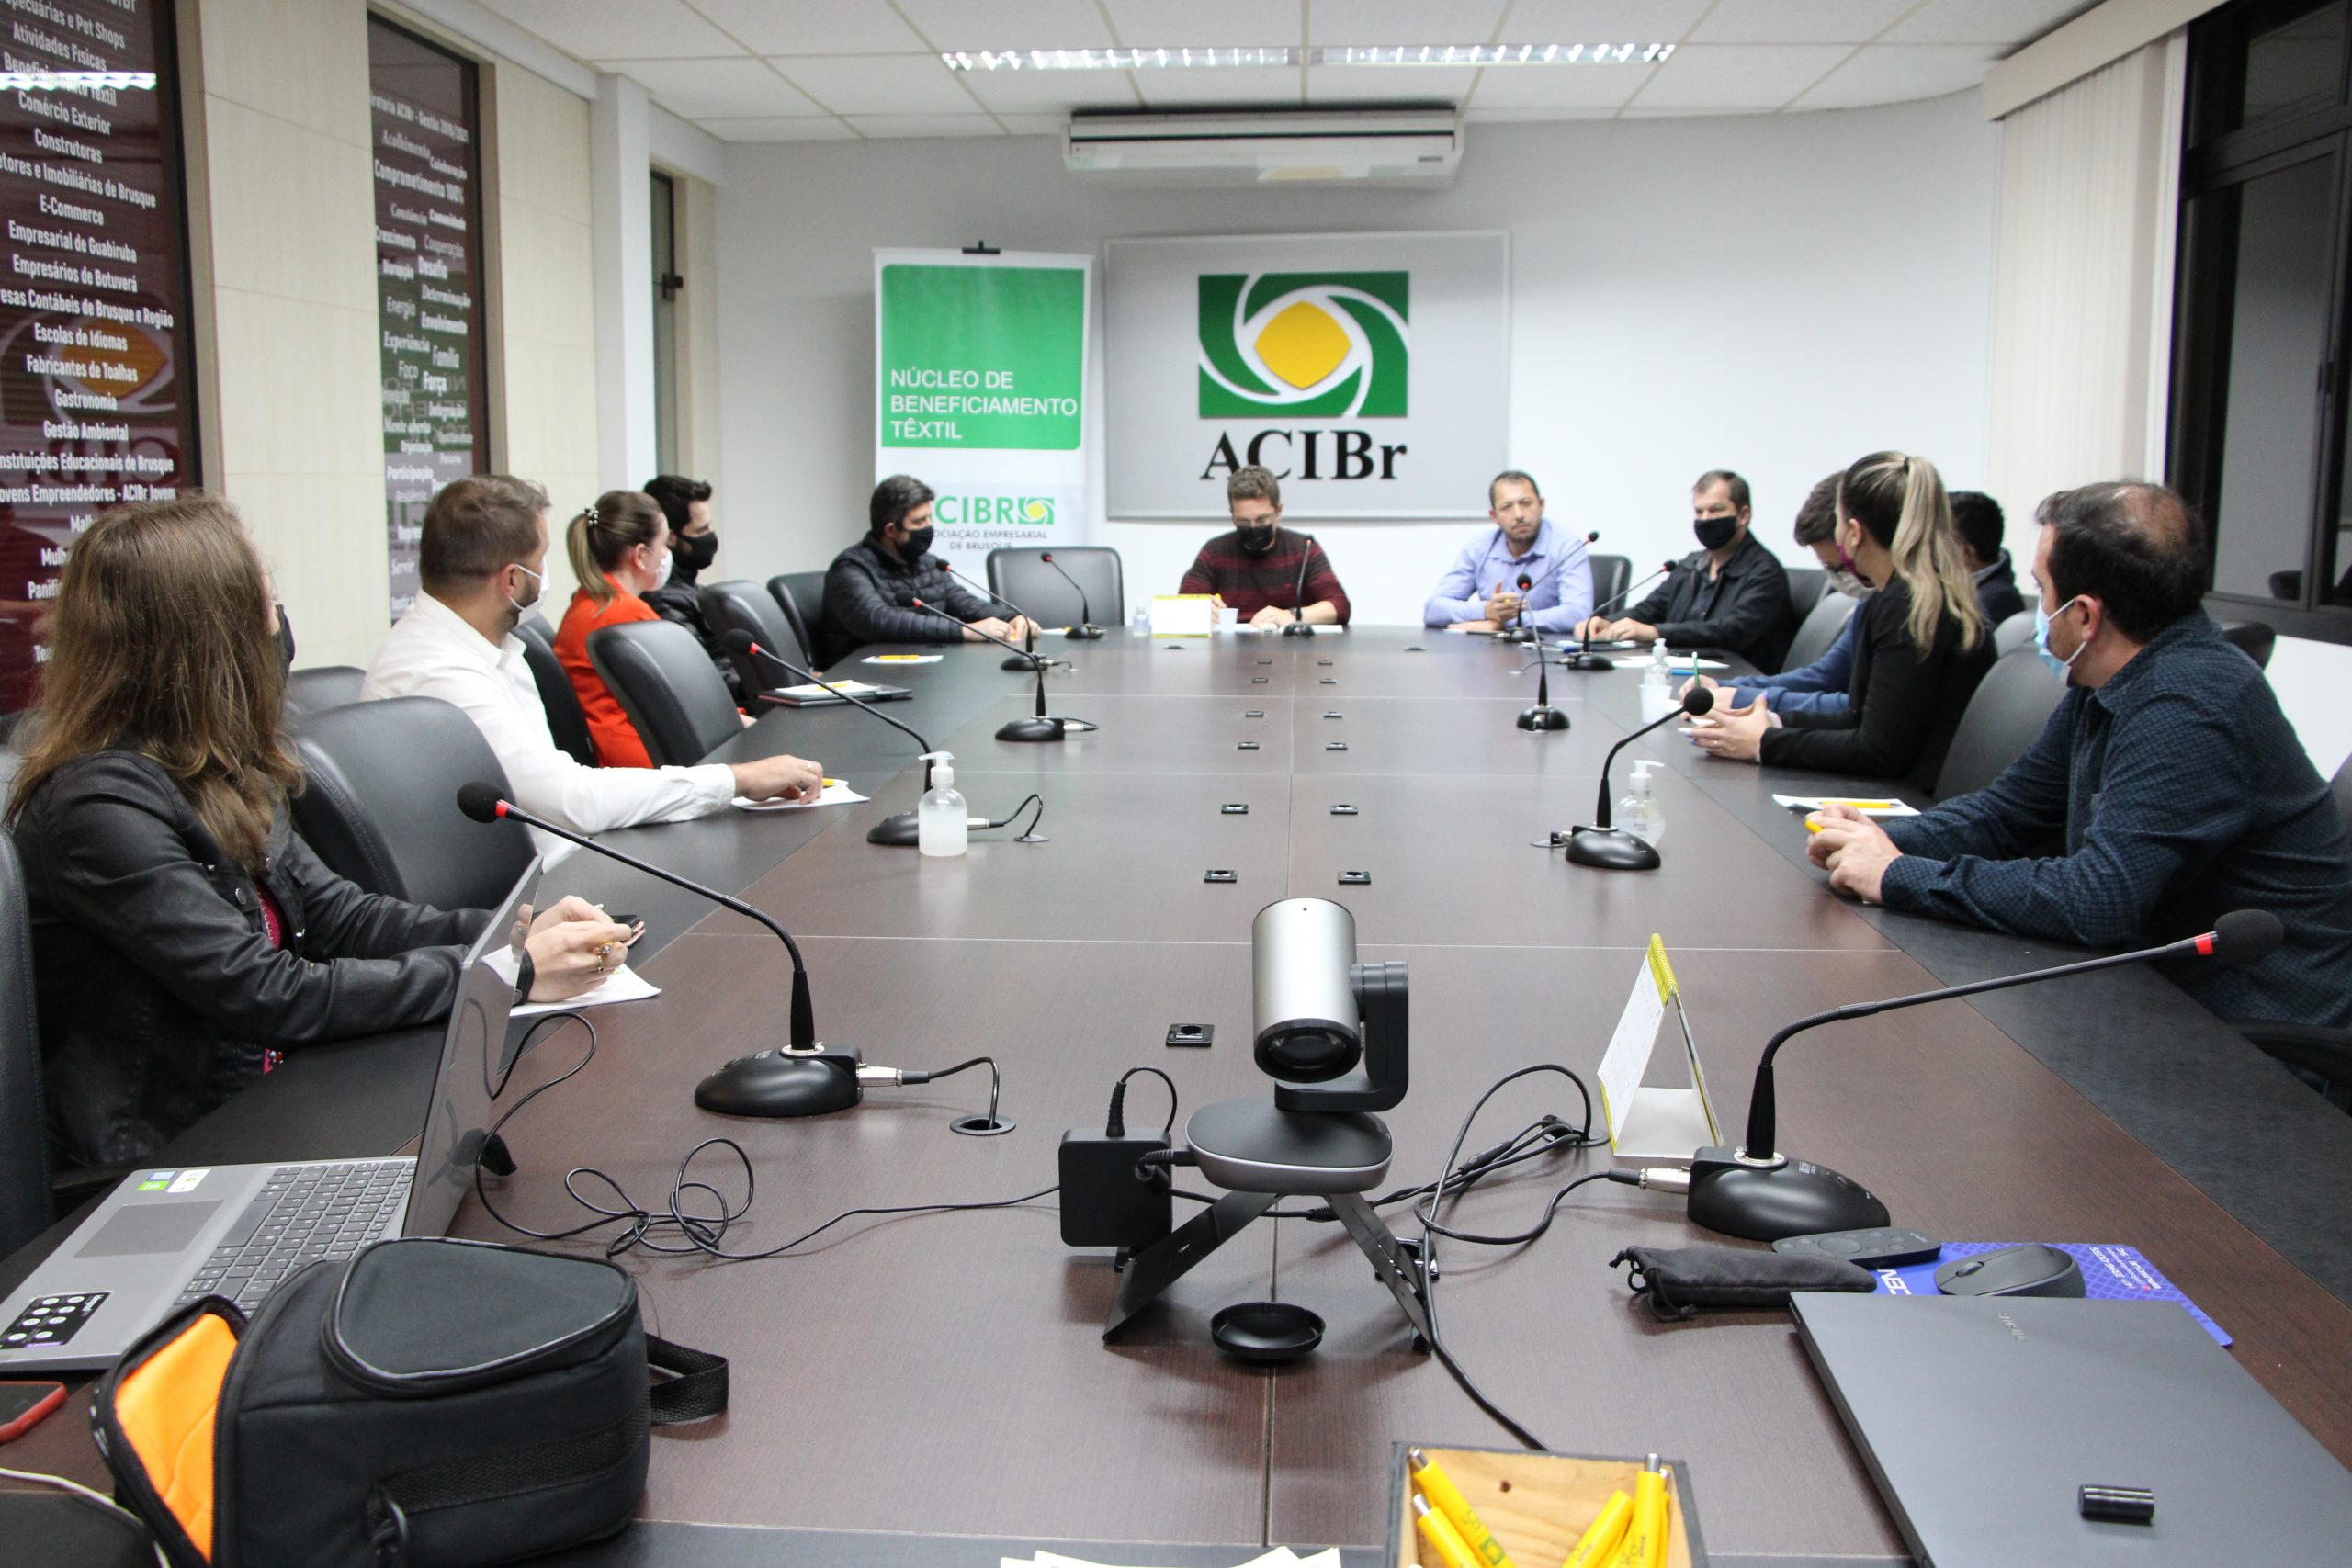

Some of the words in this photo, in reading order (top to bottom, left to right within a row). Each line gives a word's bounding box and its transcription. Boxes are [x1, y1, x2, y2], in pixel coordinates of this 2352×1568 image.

[13, 22, 71, 60] Atividades
[76, 14, 94, 36] Pet
[96, 22, 126, 49] Shops
[18, 90, 70, 123] Comércio
[72, 107, 111, 135] Exterior
[34, 128, 103, 164] Construtoras
[34, 164, 41, 178] e
[43, 163, 103, 195] Imobiliárias
[105, 179, 117, 197] de
[119, 182, 156, 209] Brusque
[40, 194, 105, 226] E-Commerce
[8, 220, 74, 252] Empresarial
[74, 234, 87, 254] de
[89, 238, 137, 264] Guabiruba
[13, 254, 80, 285] Empresários
[81, 266, 94, 285] de
[95, 268, 138, 293] Botuverá
[28, 288, 81, 314] Contábeis
[82, 298, 95, 316] de
[96, 299, 135, 324] Brusque
[136, 309, 142, 322] e
[143, 307, 175, 329] Região
[34, 322, 74, 344] Escolas
[75, 328, 88, 347] de
[90, 330, 129, 351] Idiomas
[26, 354, 87, 378] Fabricantes
[89, 361, 101, 378] de
[102, 362, 139, 382] Toalhas
[398, 359, 420, 379] Foco
[890, 366, 979, 389] NÚCLEO
[985, 370, 1013, 389] DE
[54, 389, 119, 411] Gastronomia
[890, 395, 1078, 415] BENEFICIAMENTO
[43, 420, 80, 440] Gestão
[81, 422, 130, 441] Ambiental
[890, 417, 962, 439] TÊXTIL
[60, 452, 124, 471] Educacionais
[125, 454, 137, 470] de
[138, 454, 175, 475] Brusque
[1200, 429, 1408, 480] ACIBr
[31, 483, 116, 505] Empreendedores
[122, 484, 148, 502] ACIBr
[149, 486, 176, 502] Jovem
[933, 495, 1014, 524] CIBR
[949, 541, 962, 549] DE
[983, 529, 1047, 539] EMPRESARIAL
